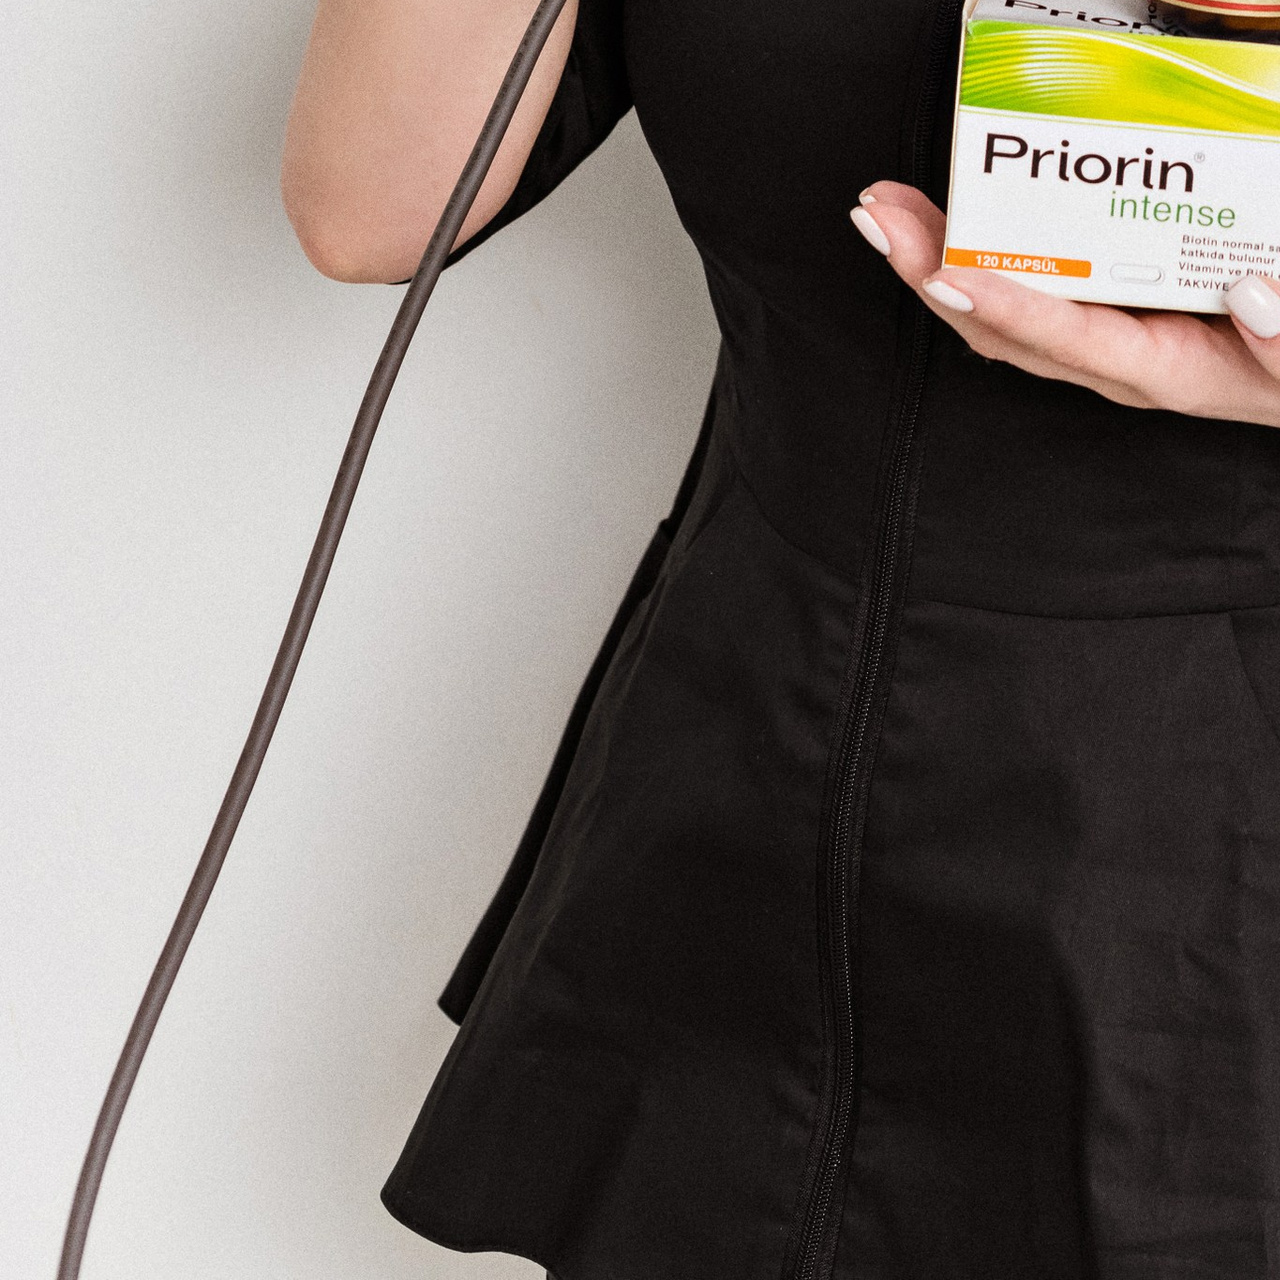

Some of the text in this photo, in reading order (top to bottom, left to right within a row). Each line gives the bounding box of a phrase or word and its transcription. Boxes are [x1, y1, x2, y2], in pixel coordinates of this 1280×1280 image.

[983, 132, 1195, 193] Priorin
[1109, 190, 1237, 229] intense
[1182, 234, 1219, 246] Biotin
[1222, 239, 1265, 251] normal
[975, 253, 1061, 274] 120 KAPSÜL
[1180, 248, 1276, 265] katkıda bulunur
[1178, 261, 1224, 275] Vitamin
[1228, 268, 1242, 277] ve
[1177, 277, 1230, 292] TAKVİYE
